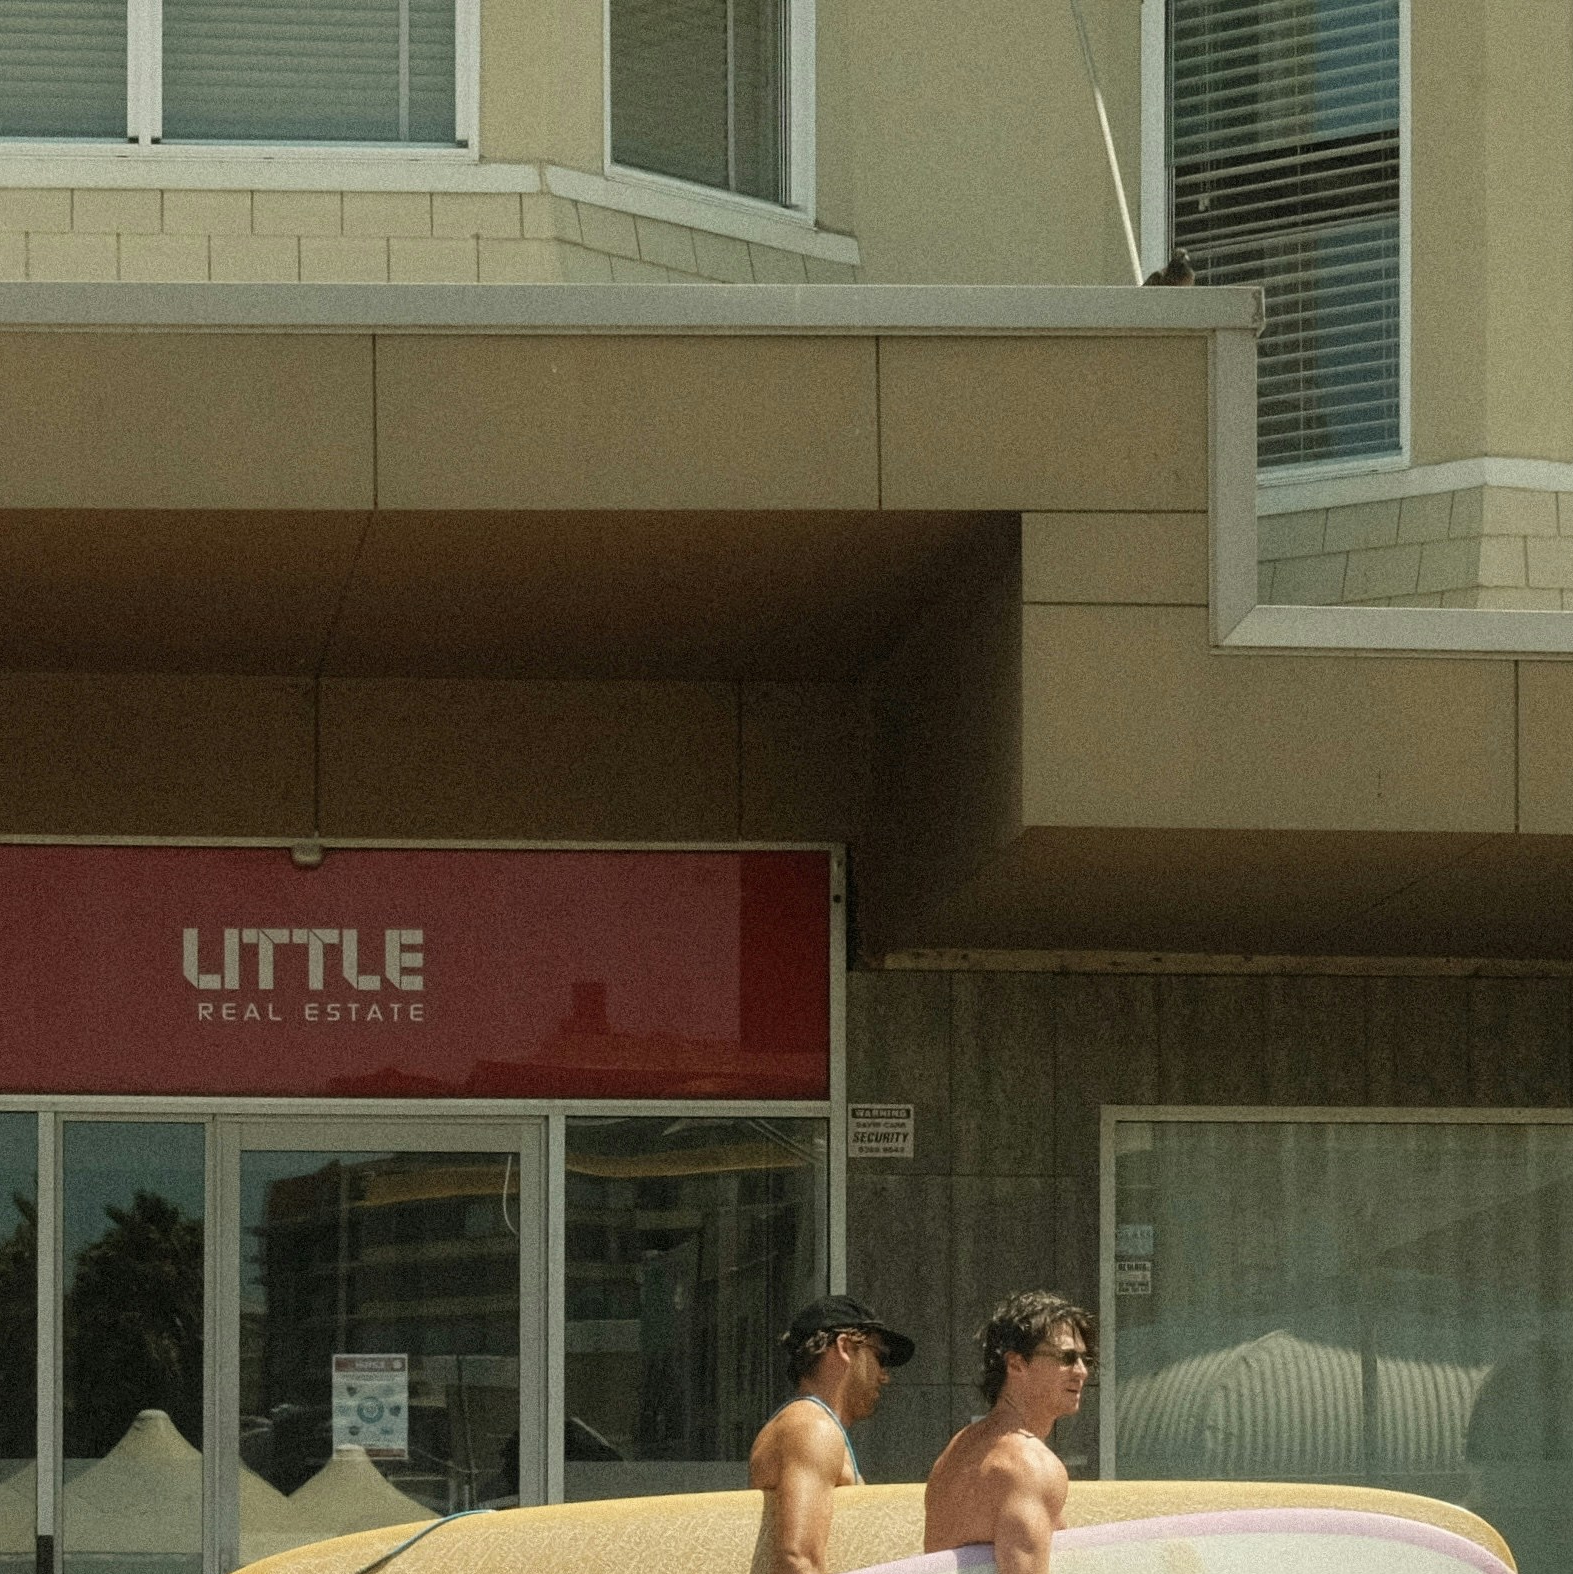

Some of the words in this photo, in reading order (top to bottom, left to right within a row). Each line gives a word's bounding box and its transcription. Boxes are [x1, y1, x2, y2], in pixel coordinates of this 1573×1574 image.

[182, 928, 424, 991] LITTLE
[198, 1003, 282, 1022] REAL
[305, 1003, 425, 1023] ESTATE
[854, 1109, 907, 1118] WARNING
[852, 1131, 909, 1144] SECURITY
